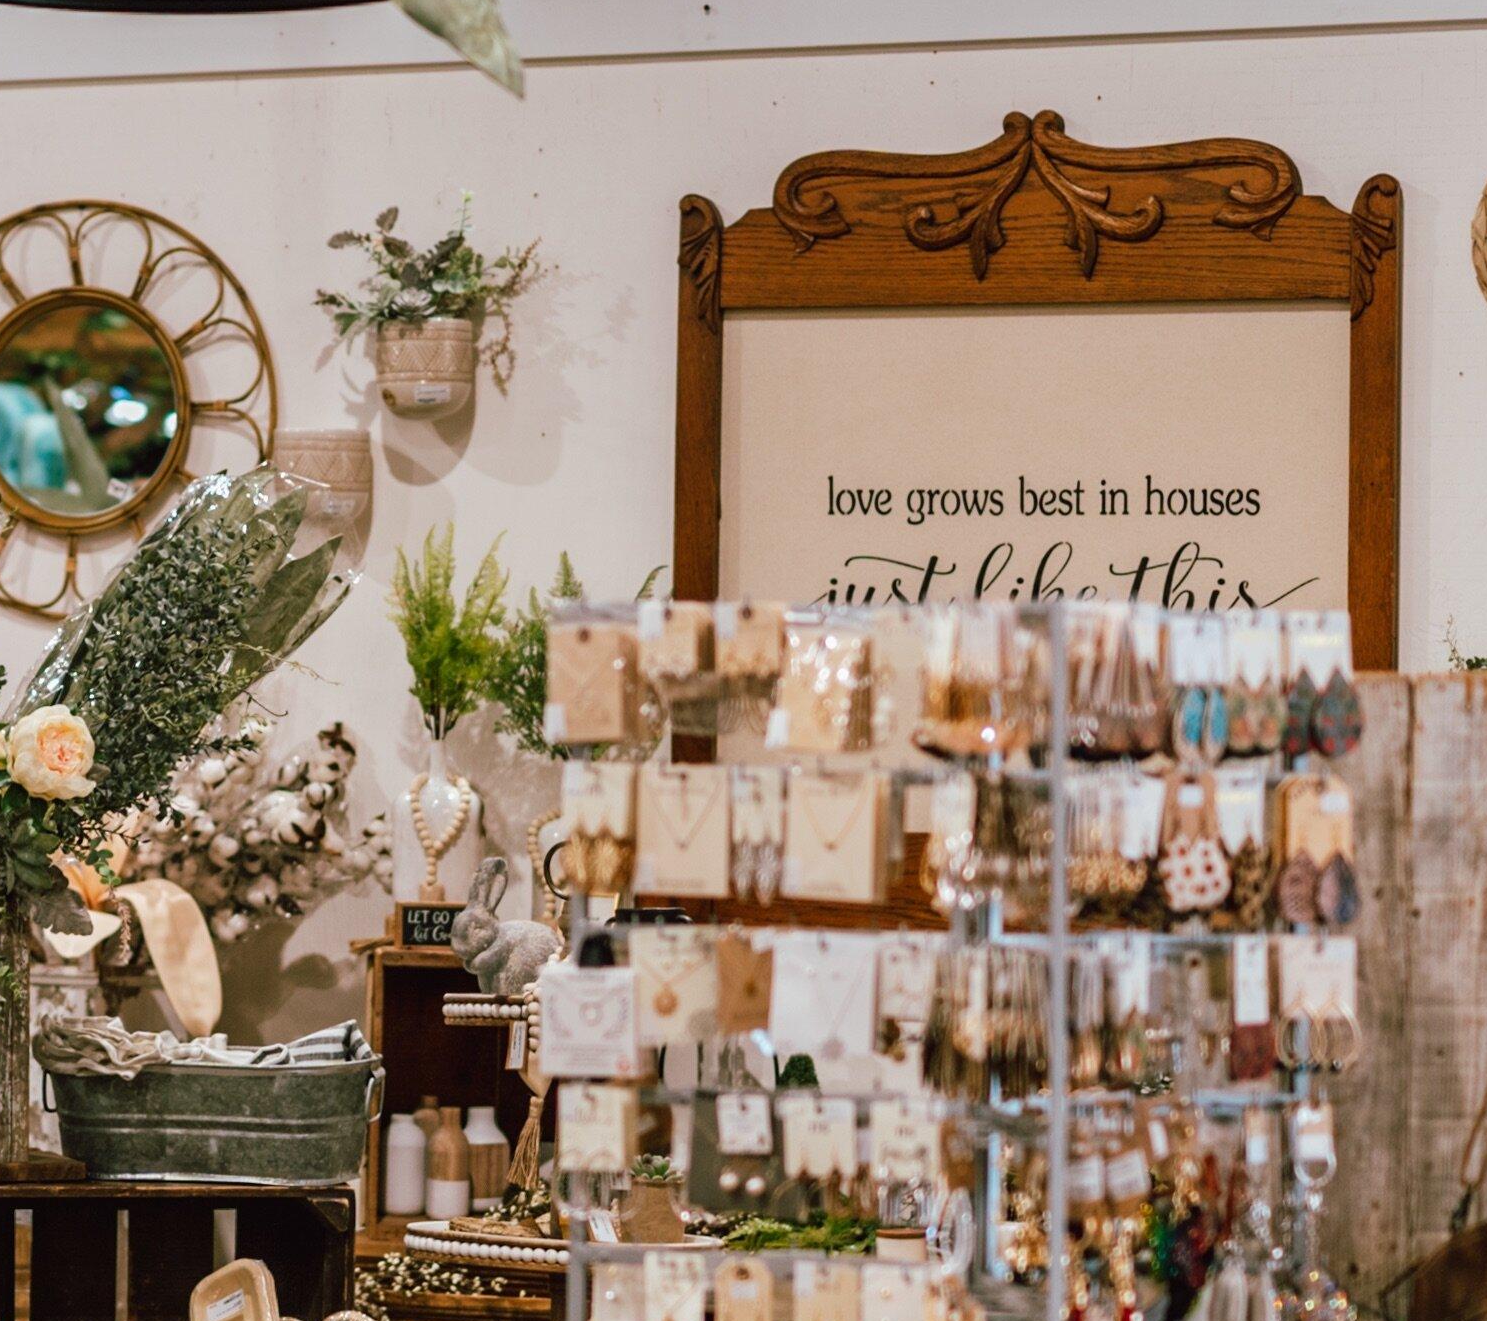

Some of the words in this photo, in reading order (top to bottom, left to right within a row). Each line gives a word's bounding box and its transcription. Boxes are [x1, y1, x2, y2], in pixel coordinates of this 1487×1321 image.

[827, 475, 893, 516] love
[906, 487, 1004, 526] grows
[1019, 475, 1085, 516] best
[1099, 479, 1129, 516] in
[1145, 475, 1261, 516] houses
[808, 555, 956, 606] just
[1109, 541, 1320, 609] this
[408, 910, 430, 924] LET
[433, 911, 450, 925] GO
